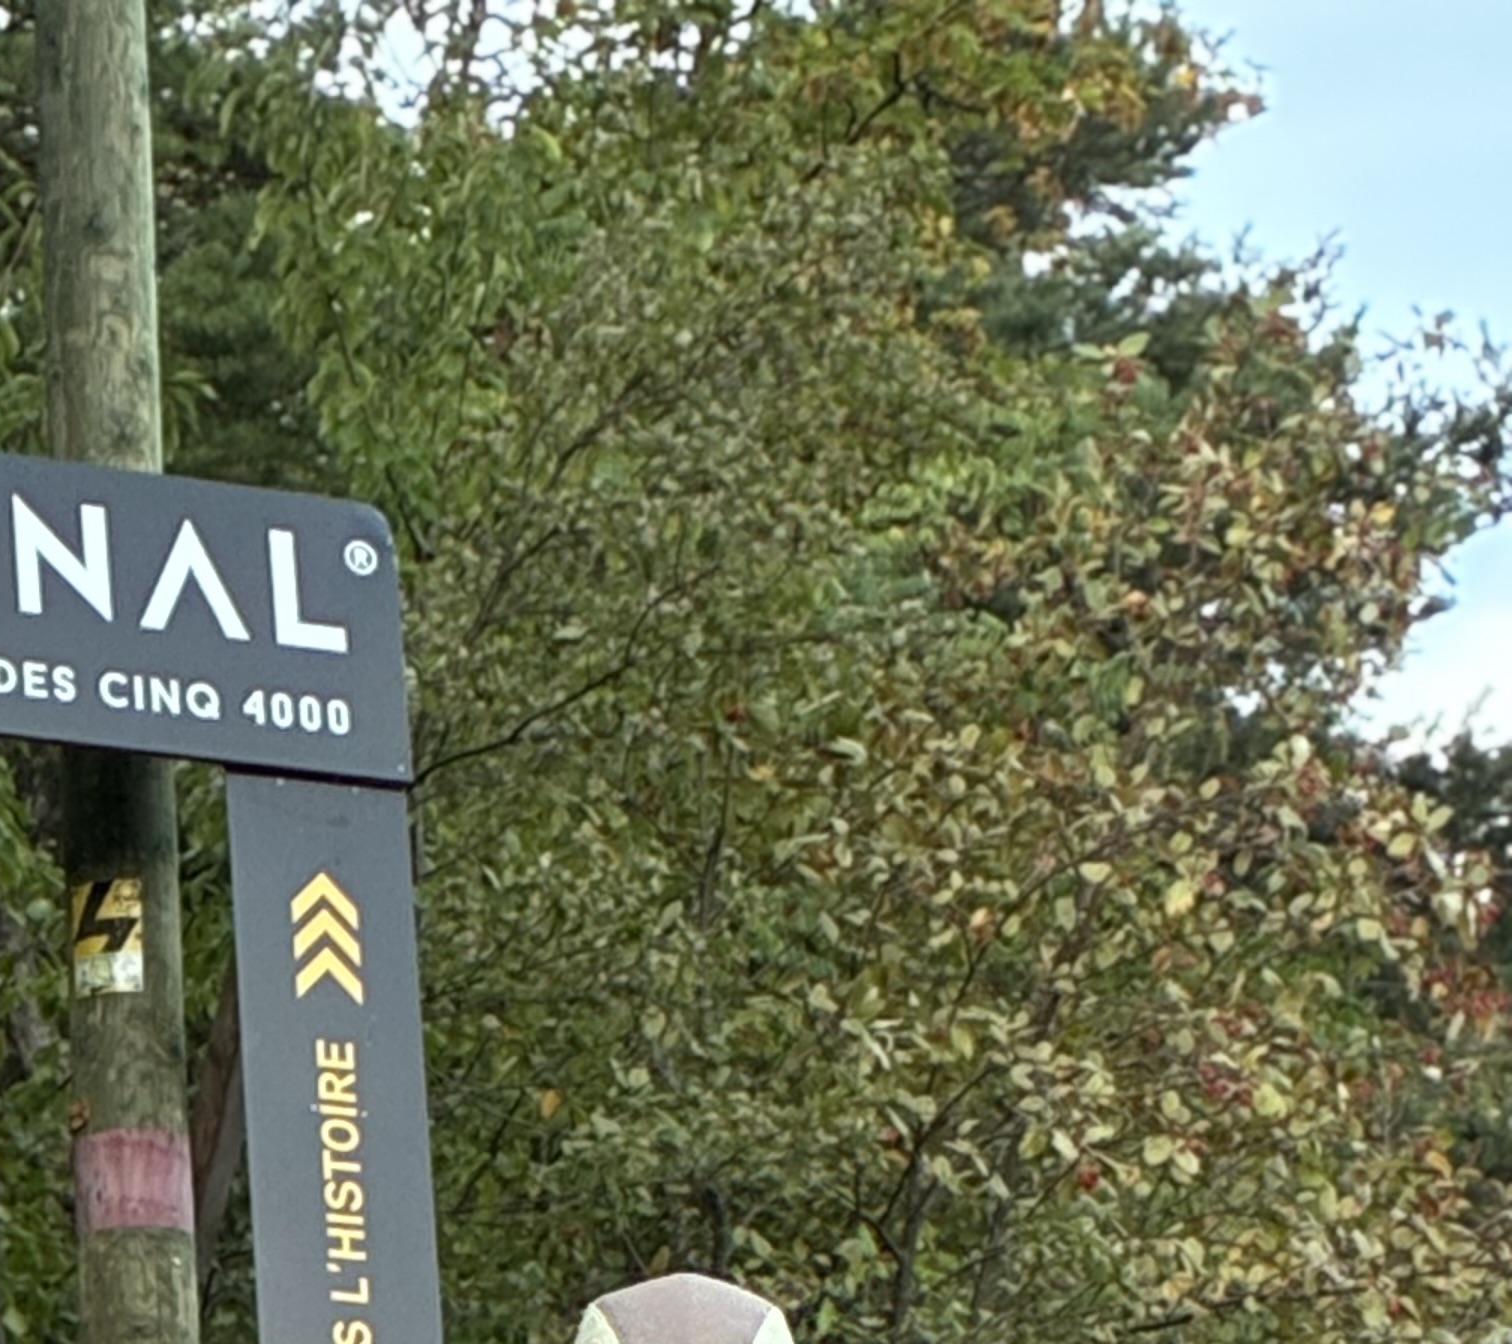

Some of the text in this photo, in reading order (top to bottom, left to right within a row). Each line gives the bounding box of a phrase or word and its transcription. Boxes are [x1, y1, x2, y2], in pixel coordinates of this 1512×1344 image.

[98, 670, 221, 721] CINQ
[241, 688, 351, 736] 4000
[314, 1037, 370, 1305] L'HISTOIRE
